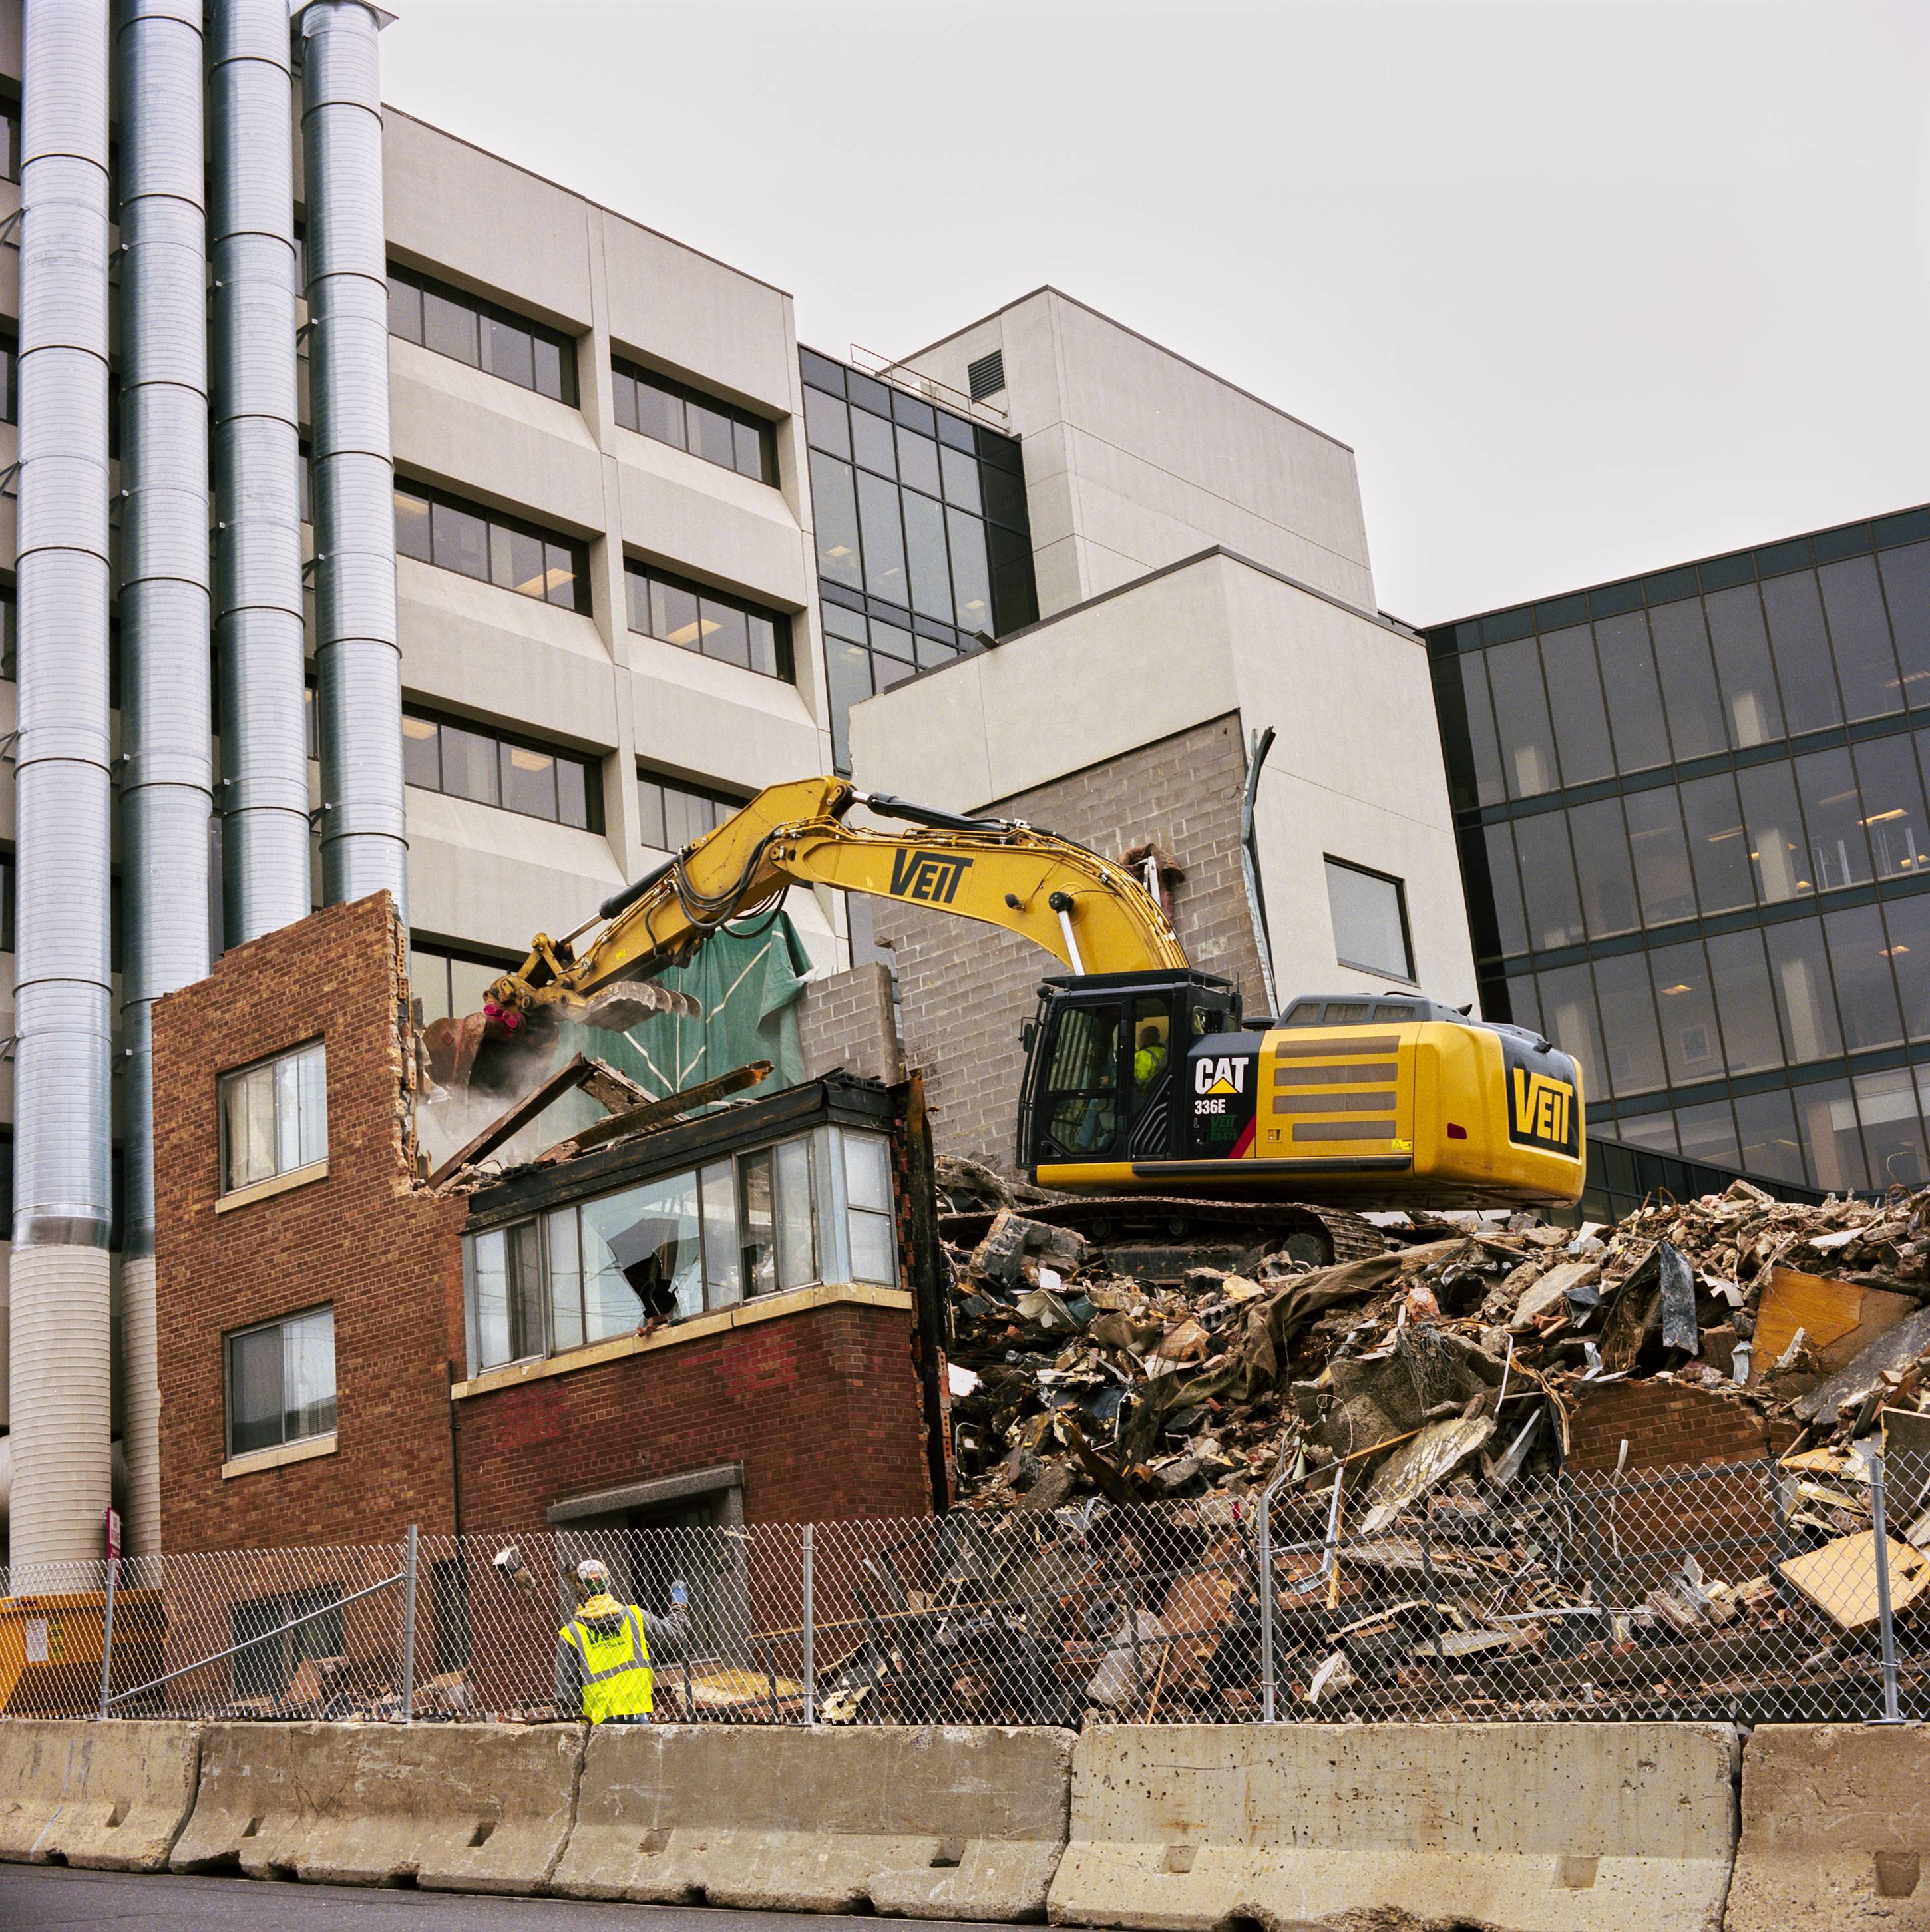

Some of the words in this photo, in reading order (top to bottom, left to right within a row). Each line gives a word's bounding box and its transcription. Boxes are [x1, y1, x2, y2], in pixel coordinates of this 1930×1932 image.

[890, 847, 974, 904] VEIT
[1195, 1057, 1249, 1095] CAT
[1194, 1099, 1226, 1115] 336E
[1513, 1067, 1573, 1145] VEIT
[1193, 1117, 1200, 1129] L
[1211, 1115, 1238, 1129] VEIT
